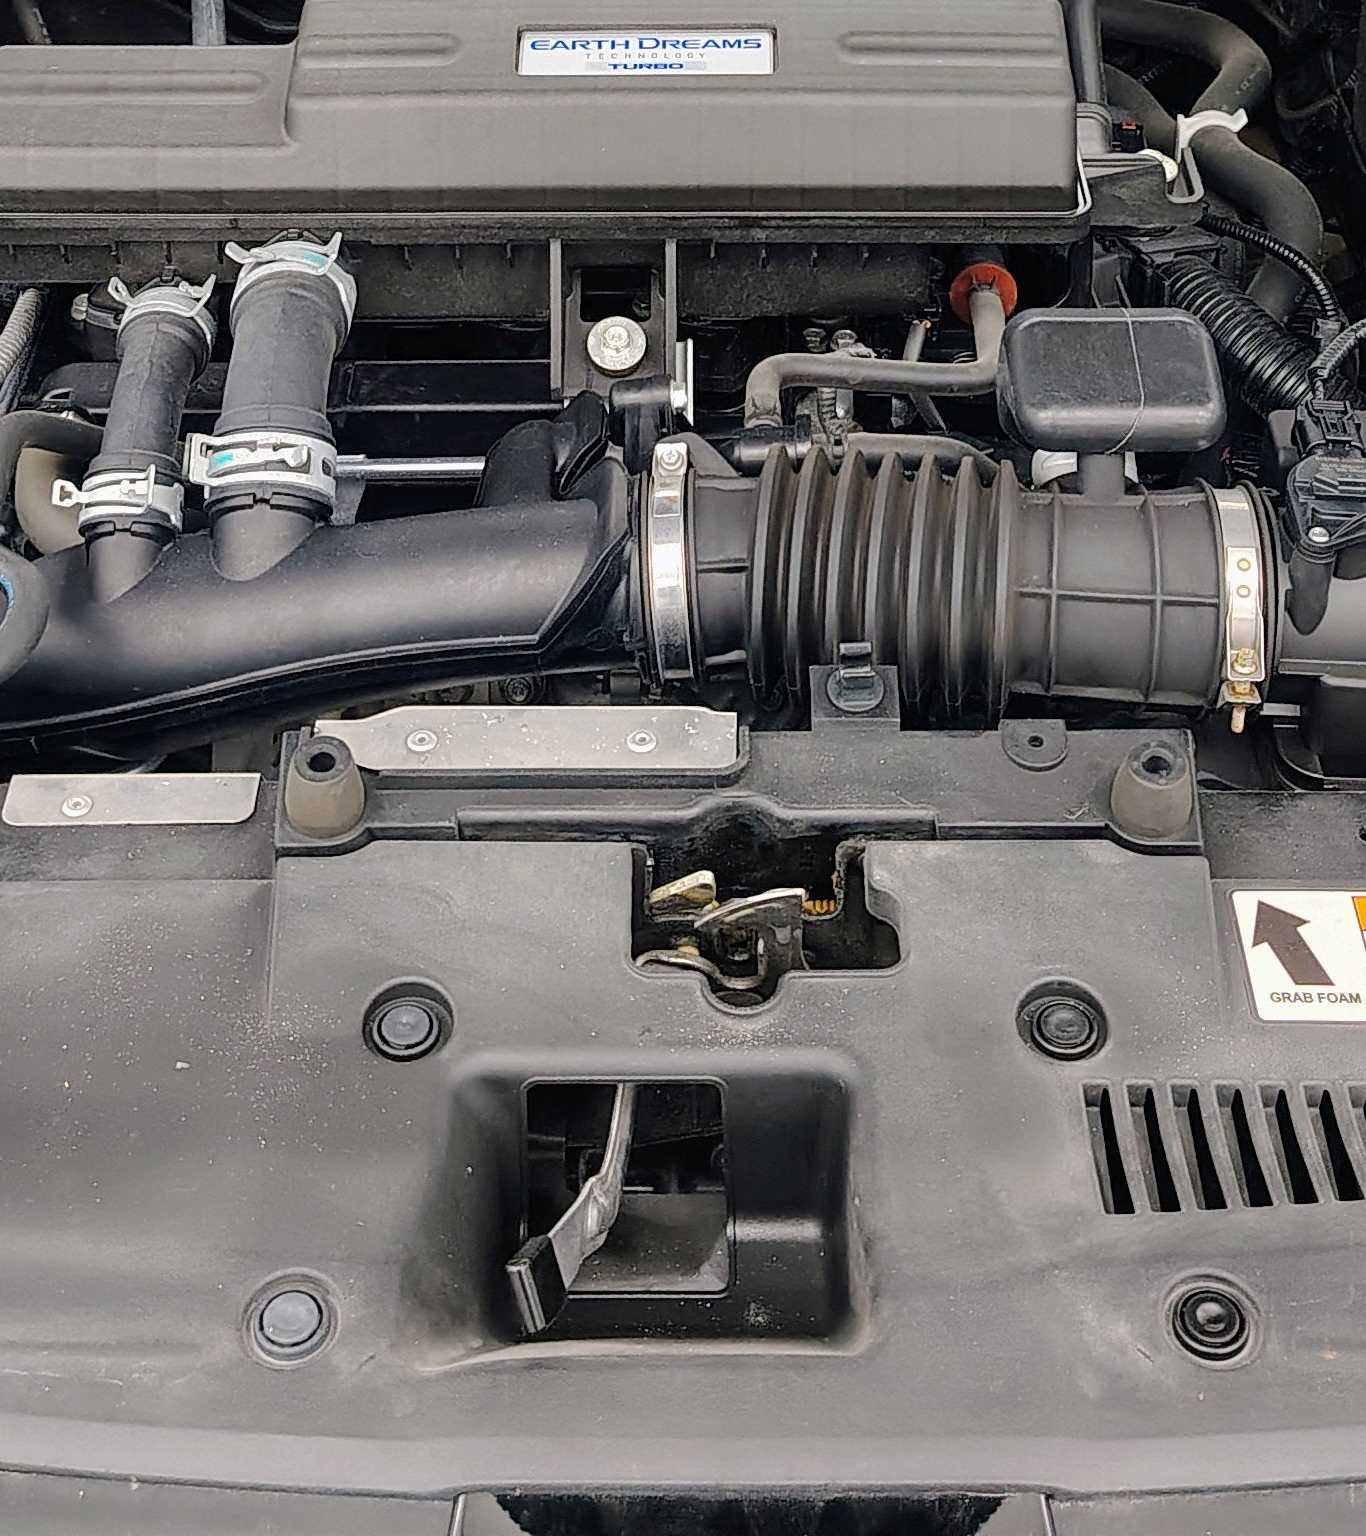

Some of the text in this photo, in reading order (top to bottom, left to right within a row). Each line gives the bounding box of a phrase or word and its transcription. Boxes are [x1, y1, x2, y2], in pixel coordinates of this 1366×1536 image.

[530, 37, 762, 51] EARTH DREAMS
[585, 52, 706, 60] TECHNOLOGY
[1270, 992, 1363, 1003] GRAB FOAM
